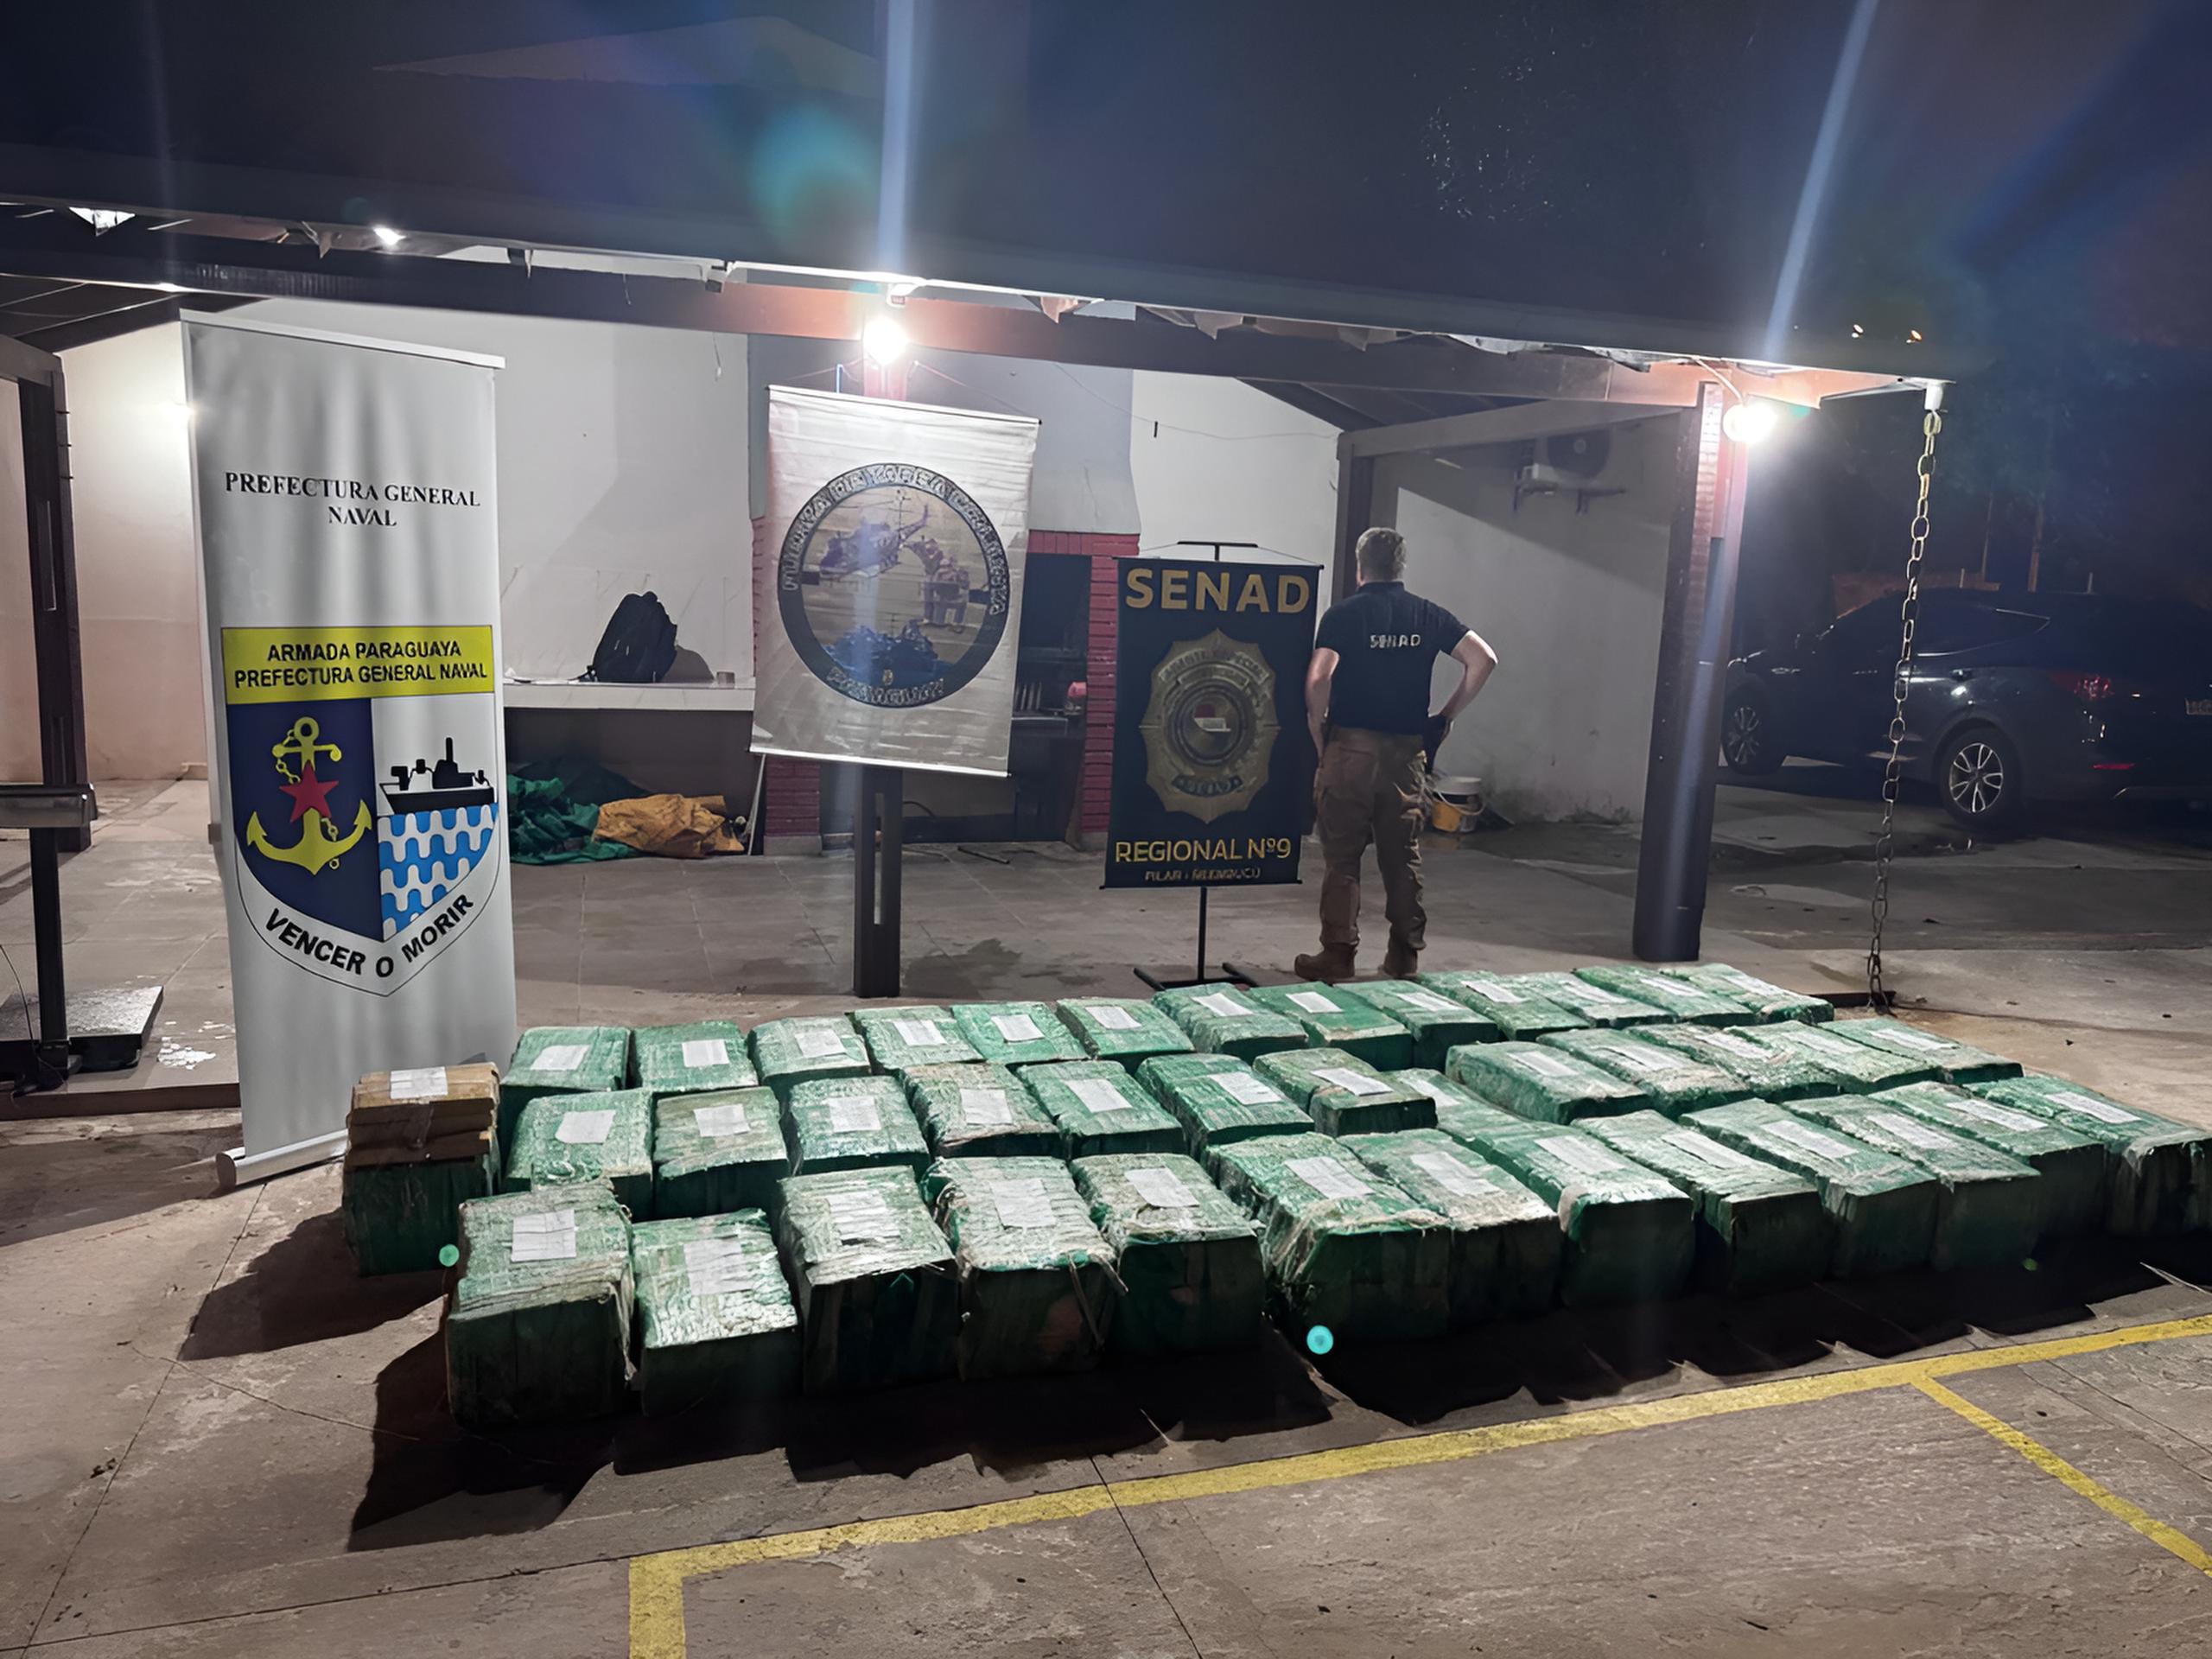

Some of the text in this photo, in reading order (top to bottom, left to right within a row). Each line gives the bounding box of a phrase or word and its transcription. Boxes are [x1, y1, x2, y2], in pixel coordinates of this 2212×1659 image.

[226, 472, 480, 507] PREFECTURA GENERAL
[328, 505, 397, 527] NAVAL
[1126, 568, 1310, 613] SENAD
[267, 640, 461, 662] ARMADA PARAGUAYA
[234, 662, 487, 688] PREFECTURA GENERAL NAVAL
[1115, 839, 1243, 862] REGIONAL
[264, 894, 474, 978] VENCER O MORIR
